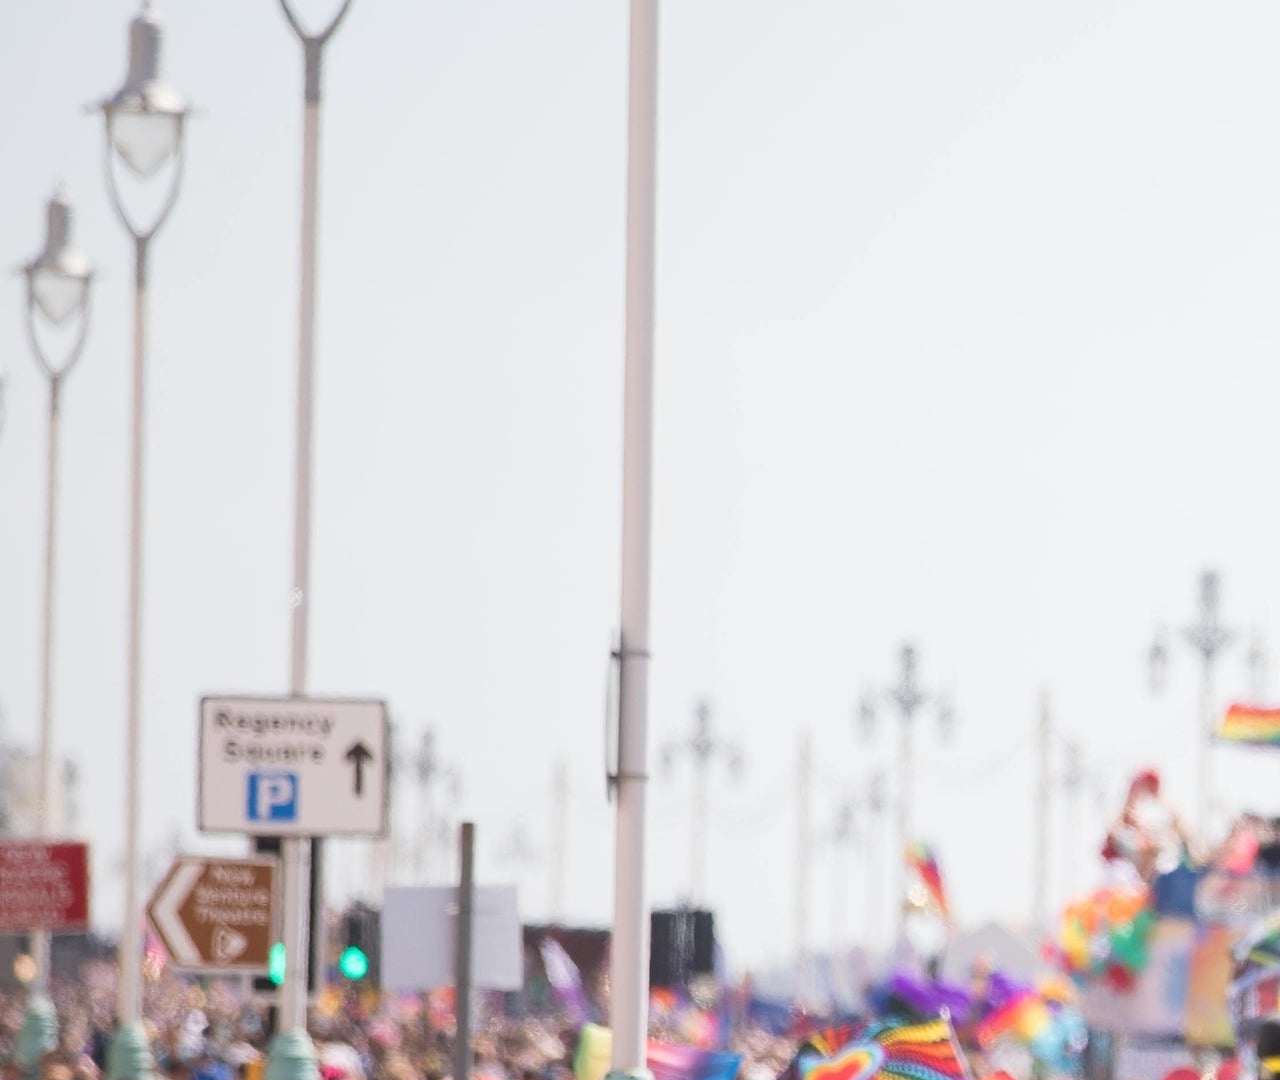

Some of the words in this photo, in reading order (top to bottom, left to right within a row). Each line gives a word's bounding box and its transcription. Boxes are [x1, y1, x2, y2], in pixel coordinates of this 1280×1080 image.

[215, 710, 335, 738] Regency
[224, 740, 324, 764] Square
[257, 775, 295, 820] P
